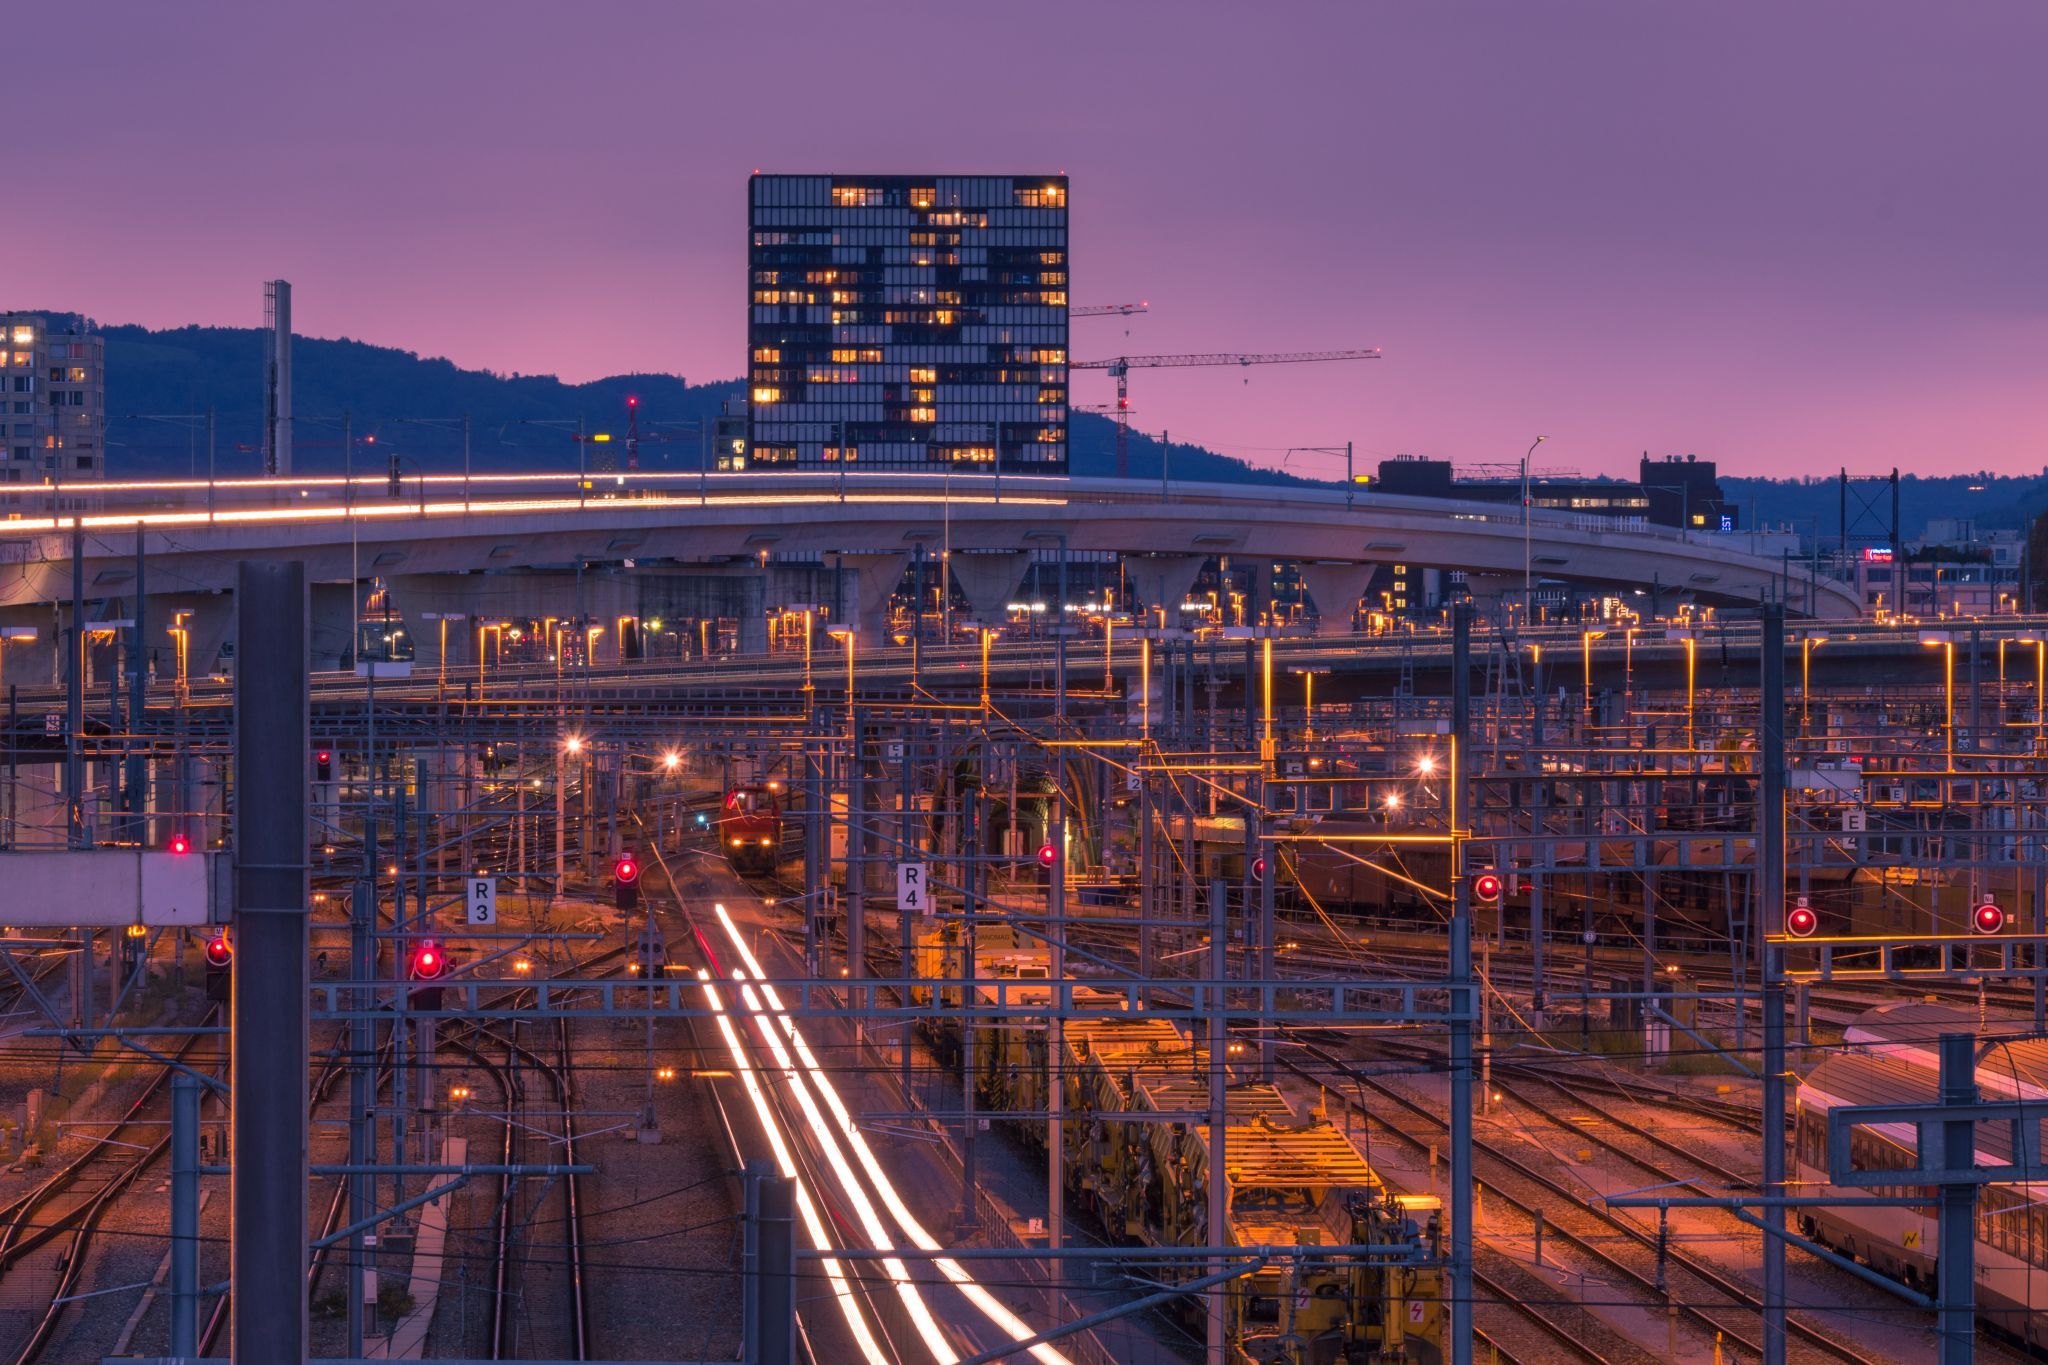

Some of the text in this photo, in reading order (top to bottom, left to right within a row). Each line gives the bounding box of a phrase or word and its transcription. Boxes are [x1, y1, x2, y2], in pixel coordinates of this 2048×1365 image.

[1849, 815, 1859, 830] E
[905, 867, 918, 884] R
[475, 882, 488, 899] R
[905, 890, 918, 907] 4
[476, 904, 488, 922] 3
